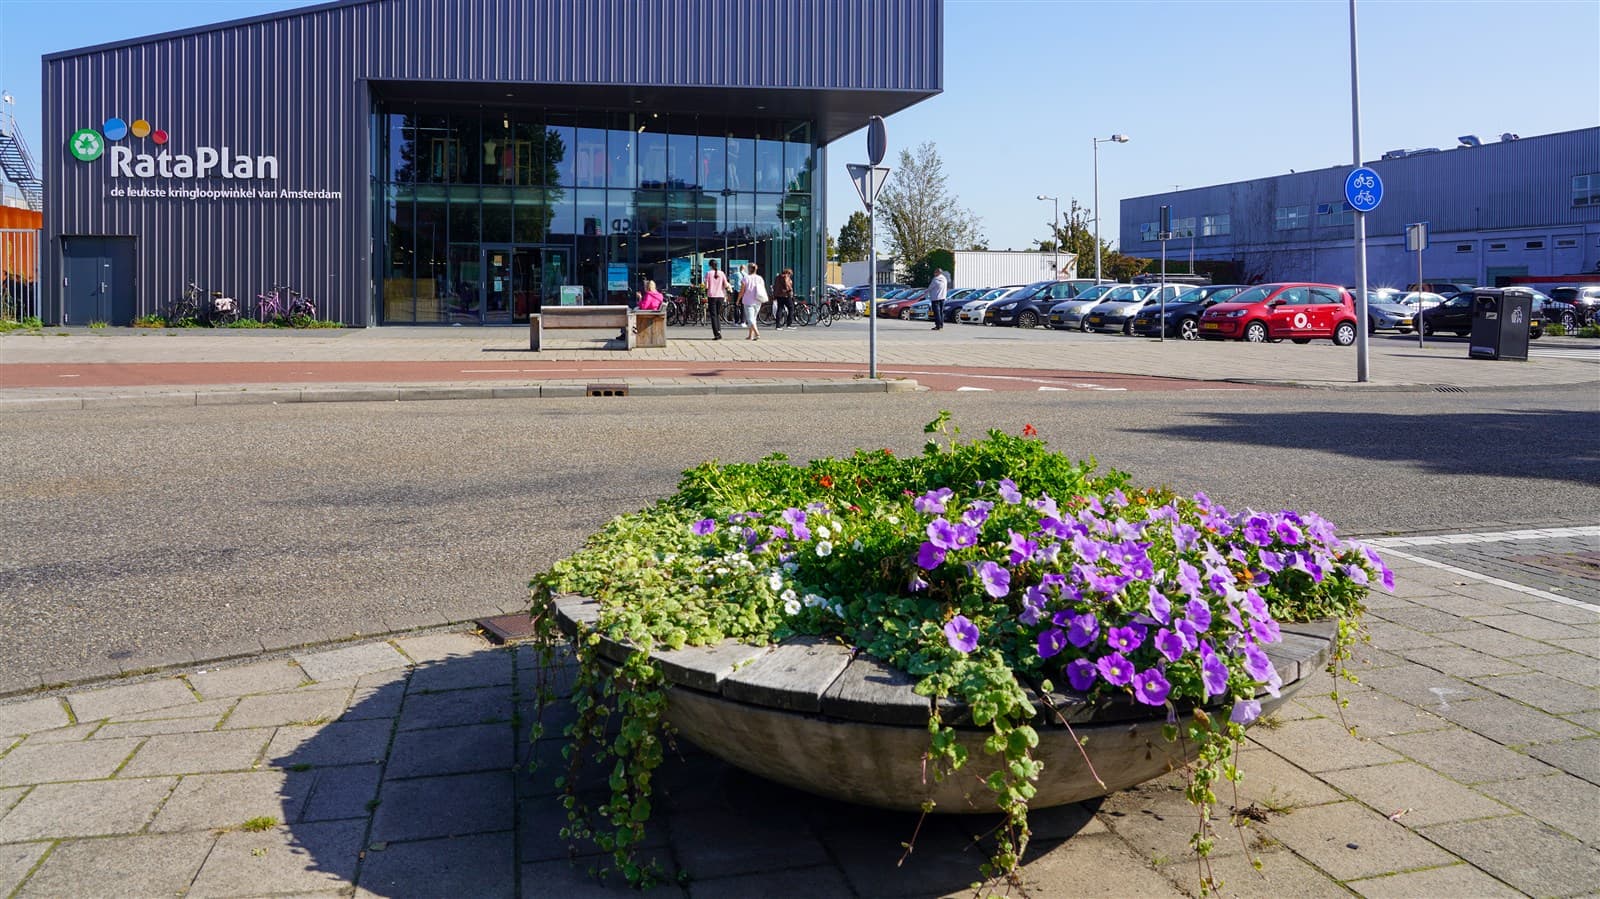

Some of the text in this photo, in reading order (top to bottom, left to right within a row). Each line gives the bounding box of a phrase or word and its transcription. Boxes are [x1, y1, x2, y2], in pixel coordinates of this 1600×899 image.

[110, 145, 279, 179] RataPlan
[110, 187, 342, 200] de leukste kringloopwinkel van Amsterdam
